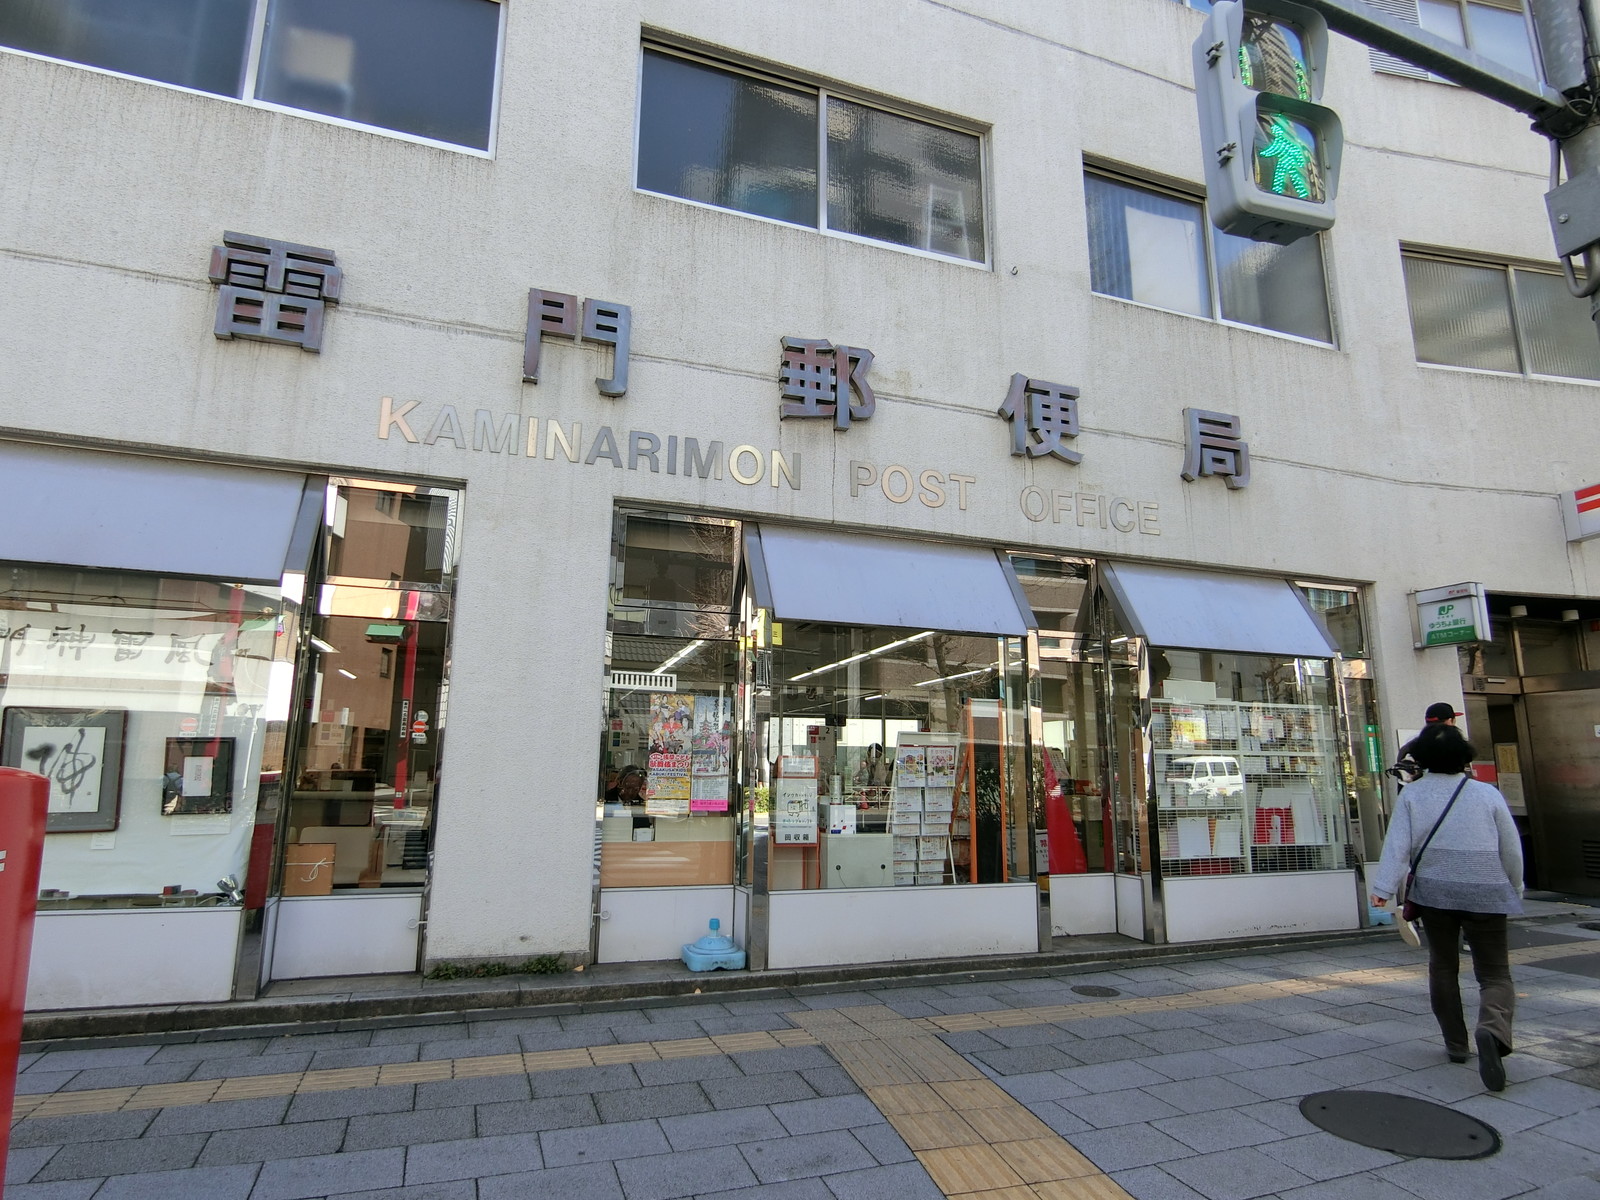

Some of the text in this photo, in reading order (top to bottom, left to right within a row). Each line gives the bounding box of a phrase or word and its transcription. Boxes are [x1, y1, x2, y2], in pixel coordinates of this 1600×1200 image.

[208, 230, 1250, 490] 雷門郵便局
[377, 396, 1161, 536] KAMINARIMON POST OFFICE
[1428, 618, 1466, 629] ゆうちょ銀行
[1430, 629, 1472, 640] ATMコーナー
